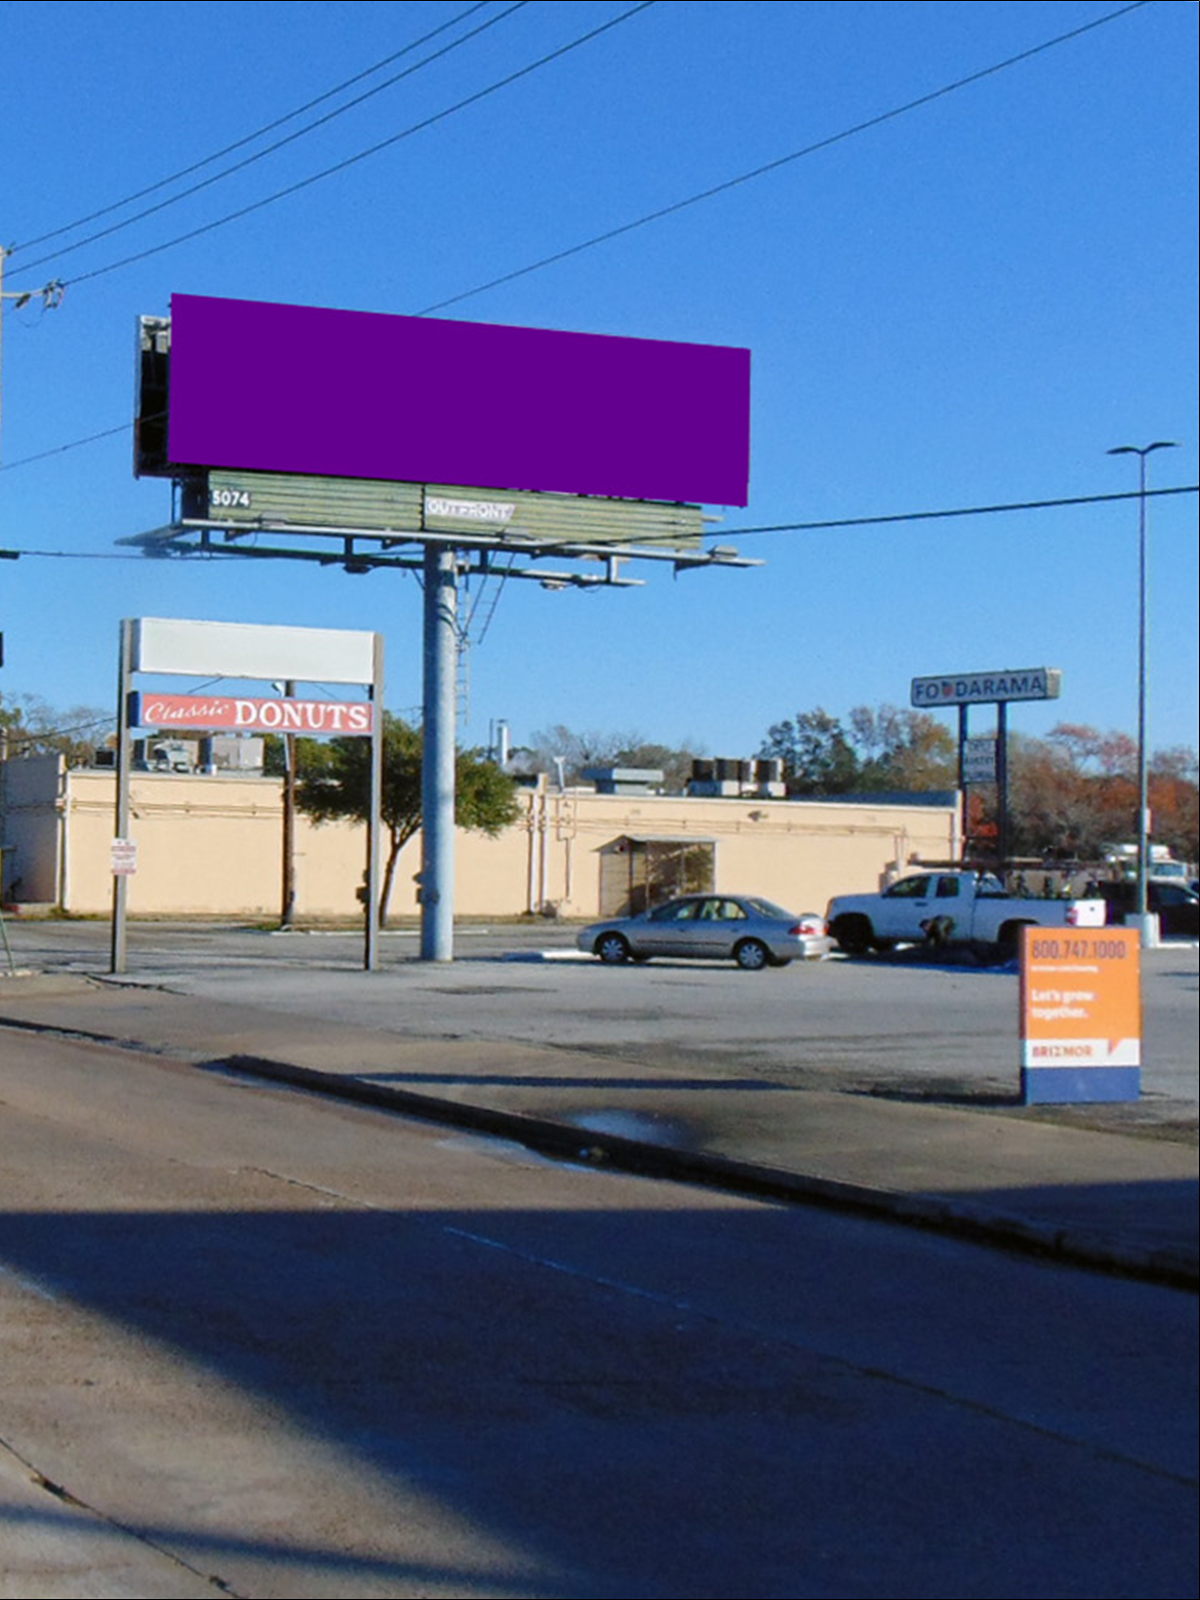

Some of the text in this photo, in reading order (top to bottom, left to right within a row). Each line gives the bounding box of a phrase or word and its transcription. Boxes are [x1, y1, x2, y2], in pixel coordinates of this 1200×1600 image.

[212, 491, 250, 506] 5074
[428, 499, 513, 519] OUTFRONT
[144, 700, 369, 729] Classic DONUTS
[1032, 940, 1126, 959] 800.747.1000
